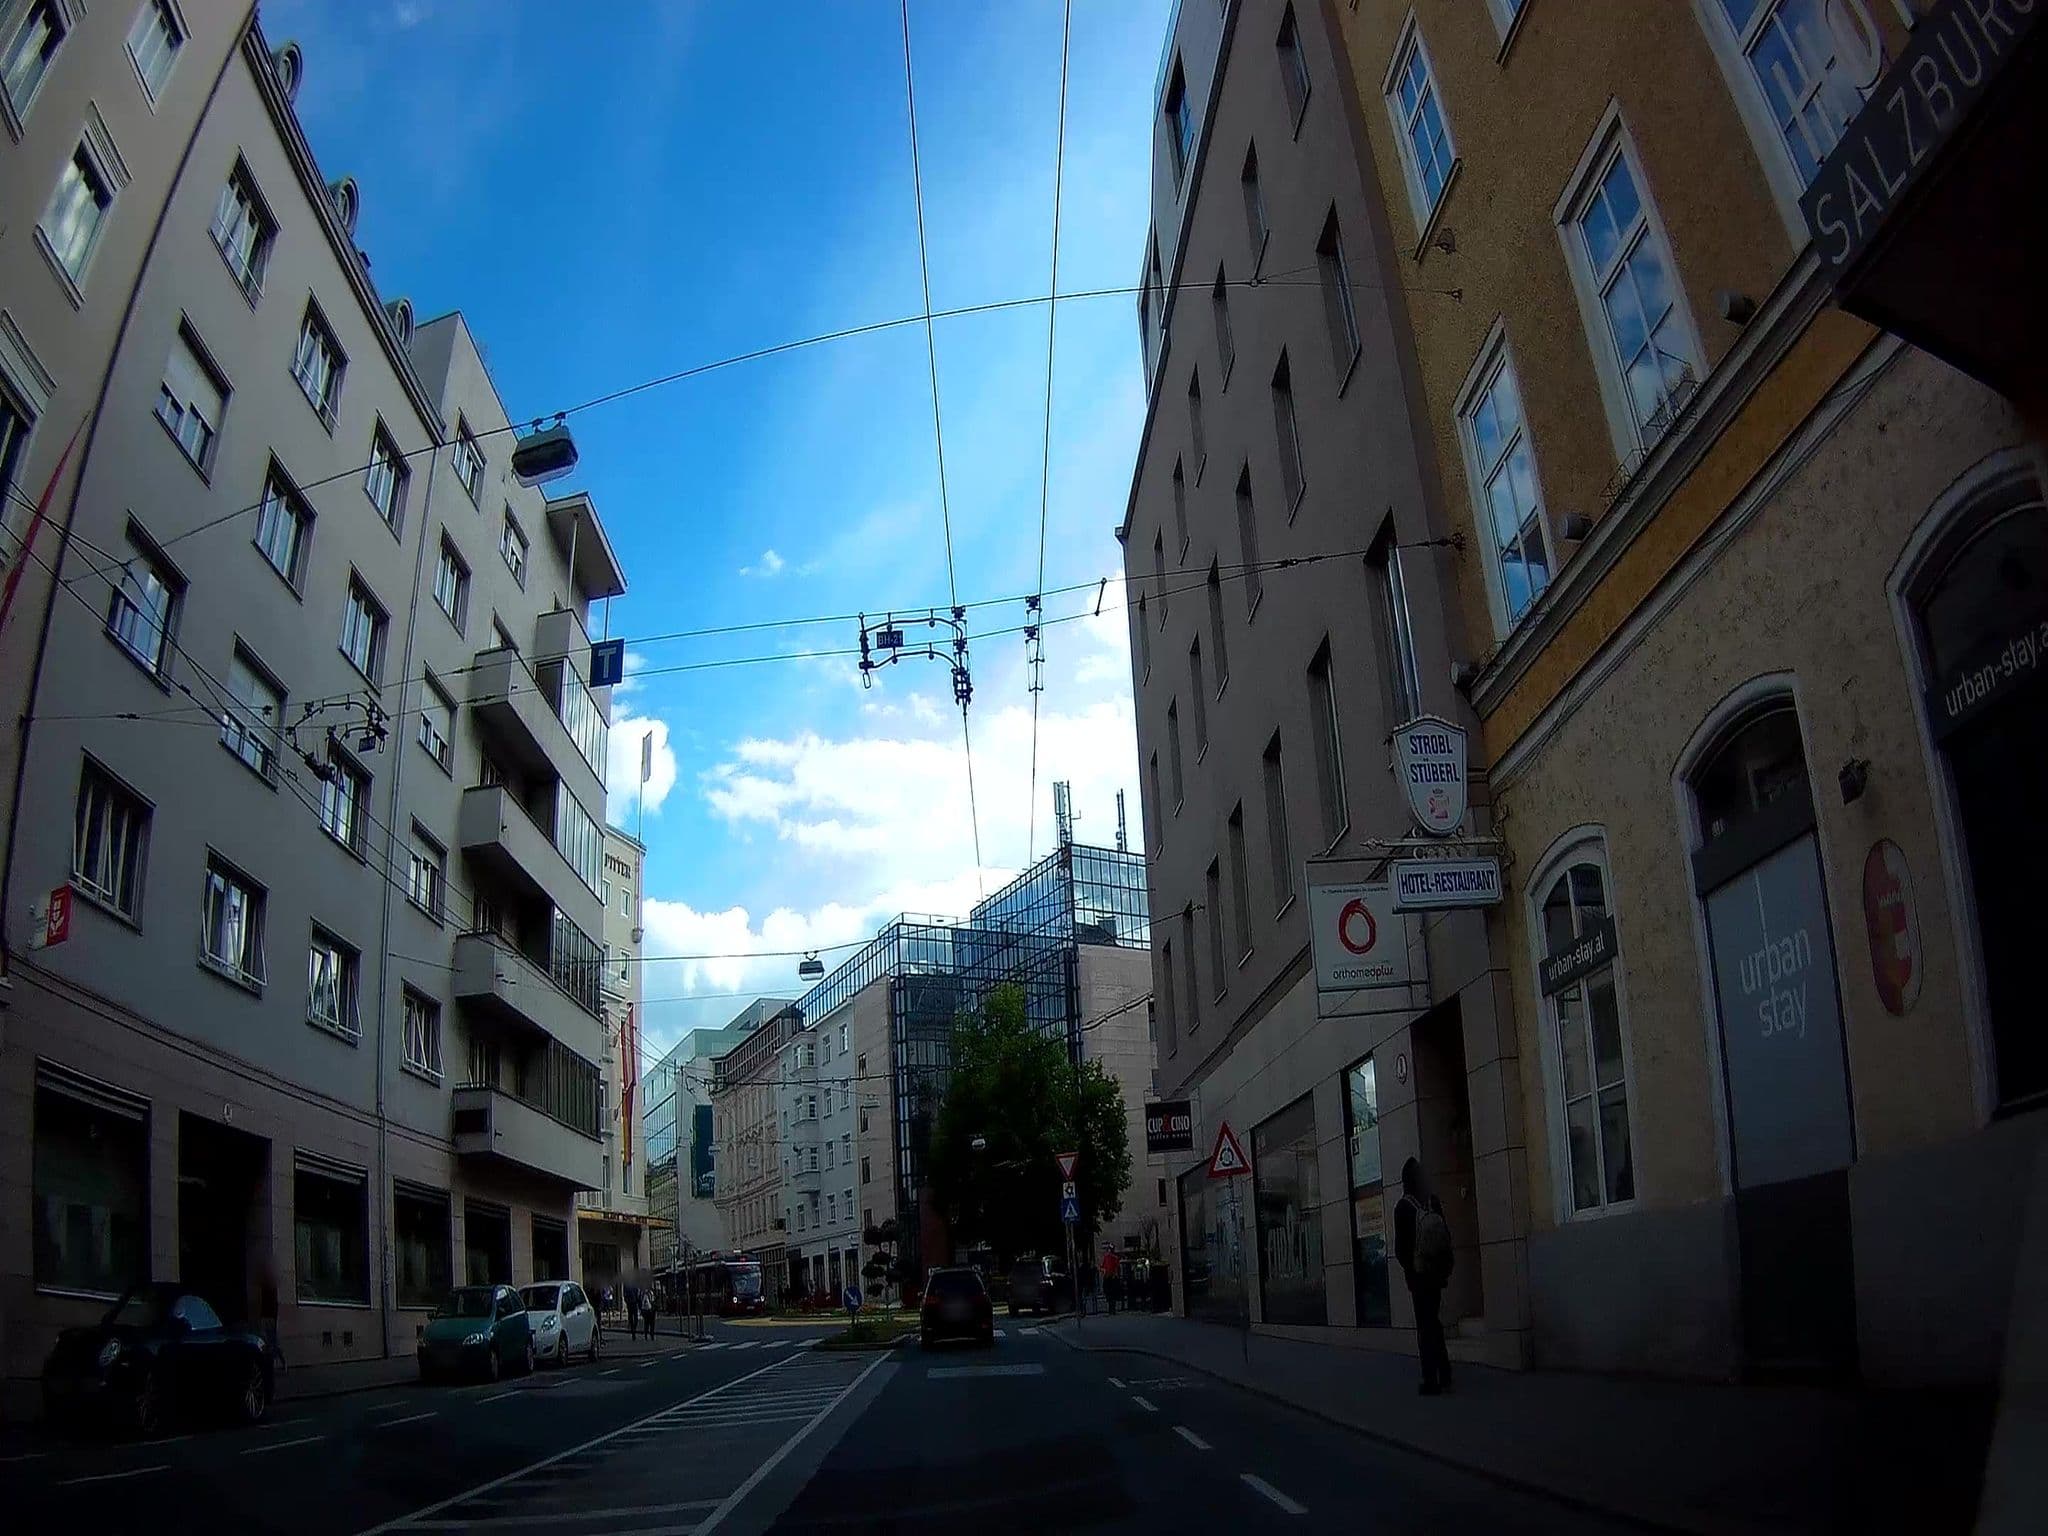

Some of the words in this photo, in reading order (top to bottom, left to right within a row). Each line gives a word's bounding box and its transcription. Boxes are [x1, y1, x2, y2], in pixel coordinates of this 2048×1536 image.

[1816, 0, 2034, 265] SALZBUR
[1409, 734, 1453, 755] STROBL
[1409, 757, 1460, 783] STÜBERL
[1400, 870, 1495, 895] HOTEL-RESTAURANT
[1547, 930, 1605, 981] urban-stay.at
[1739, 928, 1811, 994] urban
[1758, 980, 1808, 1038] stay
